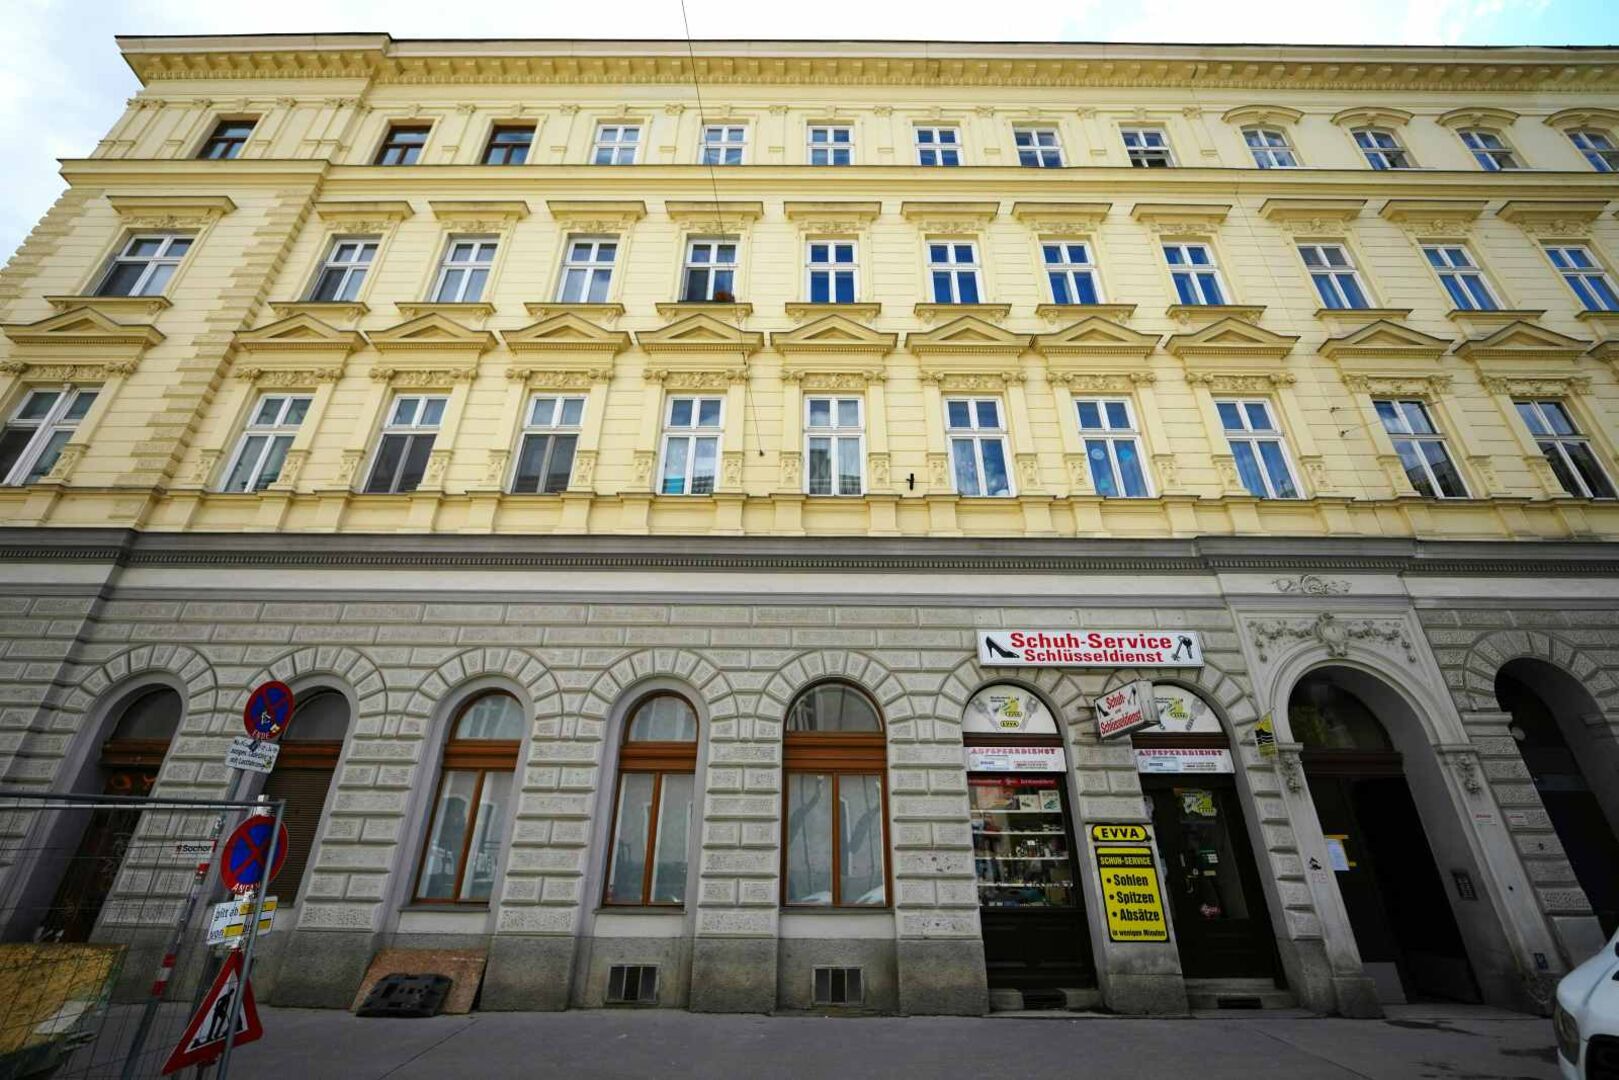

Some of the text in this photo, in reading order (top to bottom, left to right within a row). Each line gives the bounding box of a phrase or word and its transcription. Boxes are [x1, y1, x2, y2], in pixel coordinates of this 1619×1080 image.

[1010, 632, 1172, 649] Schuh-Service
[1024, 649, 1164, 663] Schlüsseldienst
[1101, 827, 1140, 838] EVVA
[1100, 856, 1153, 866] SCHUH-SERVICE
[1113, 873, 1149, 886] Sohlen
[1116, 891, 1155, 904] Spitzen
[1120, 908, 1160, 922] Absätze
